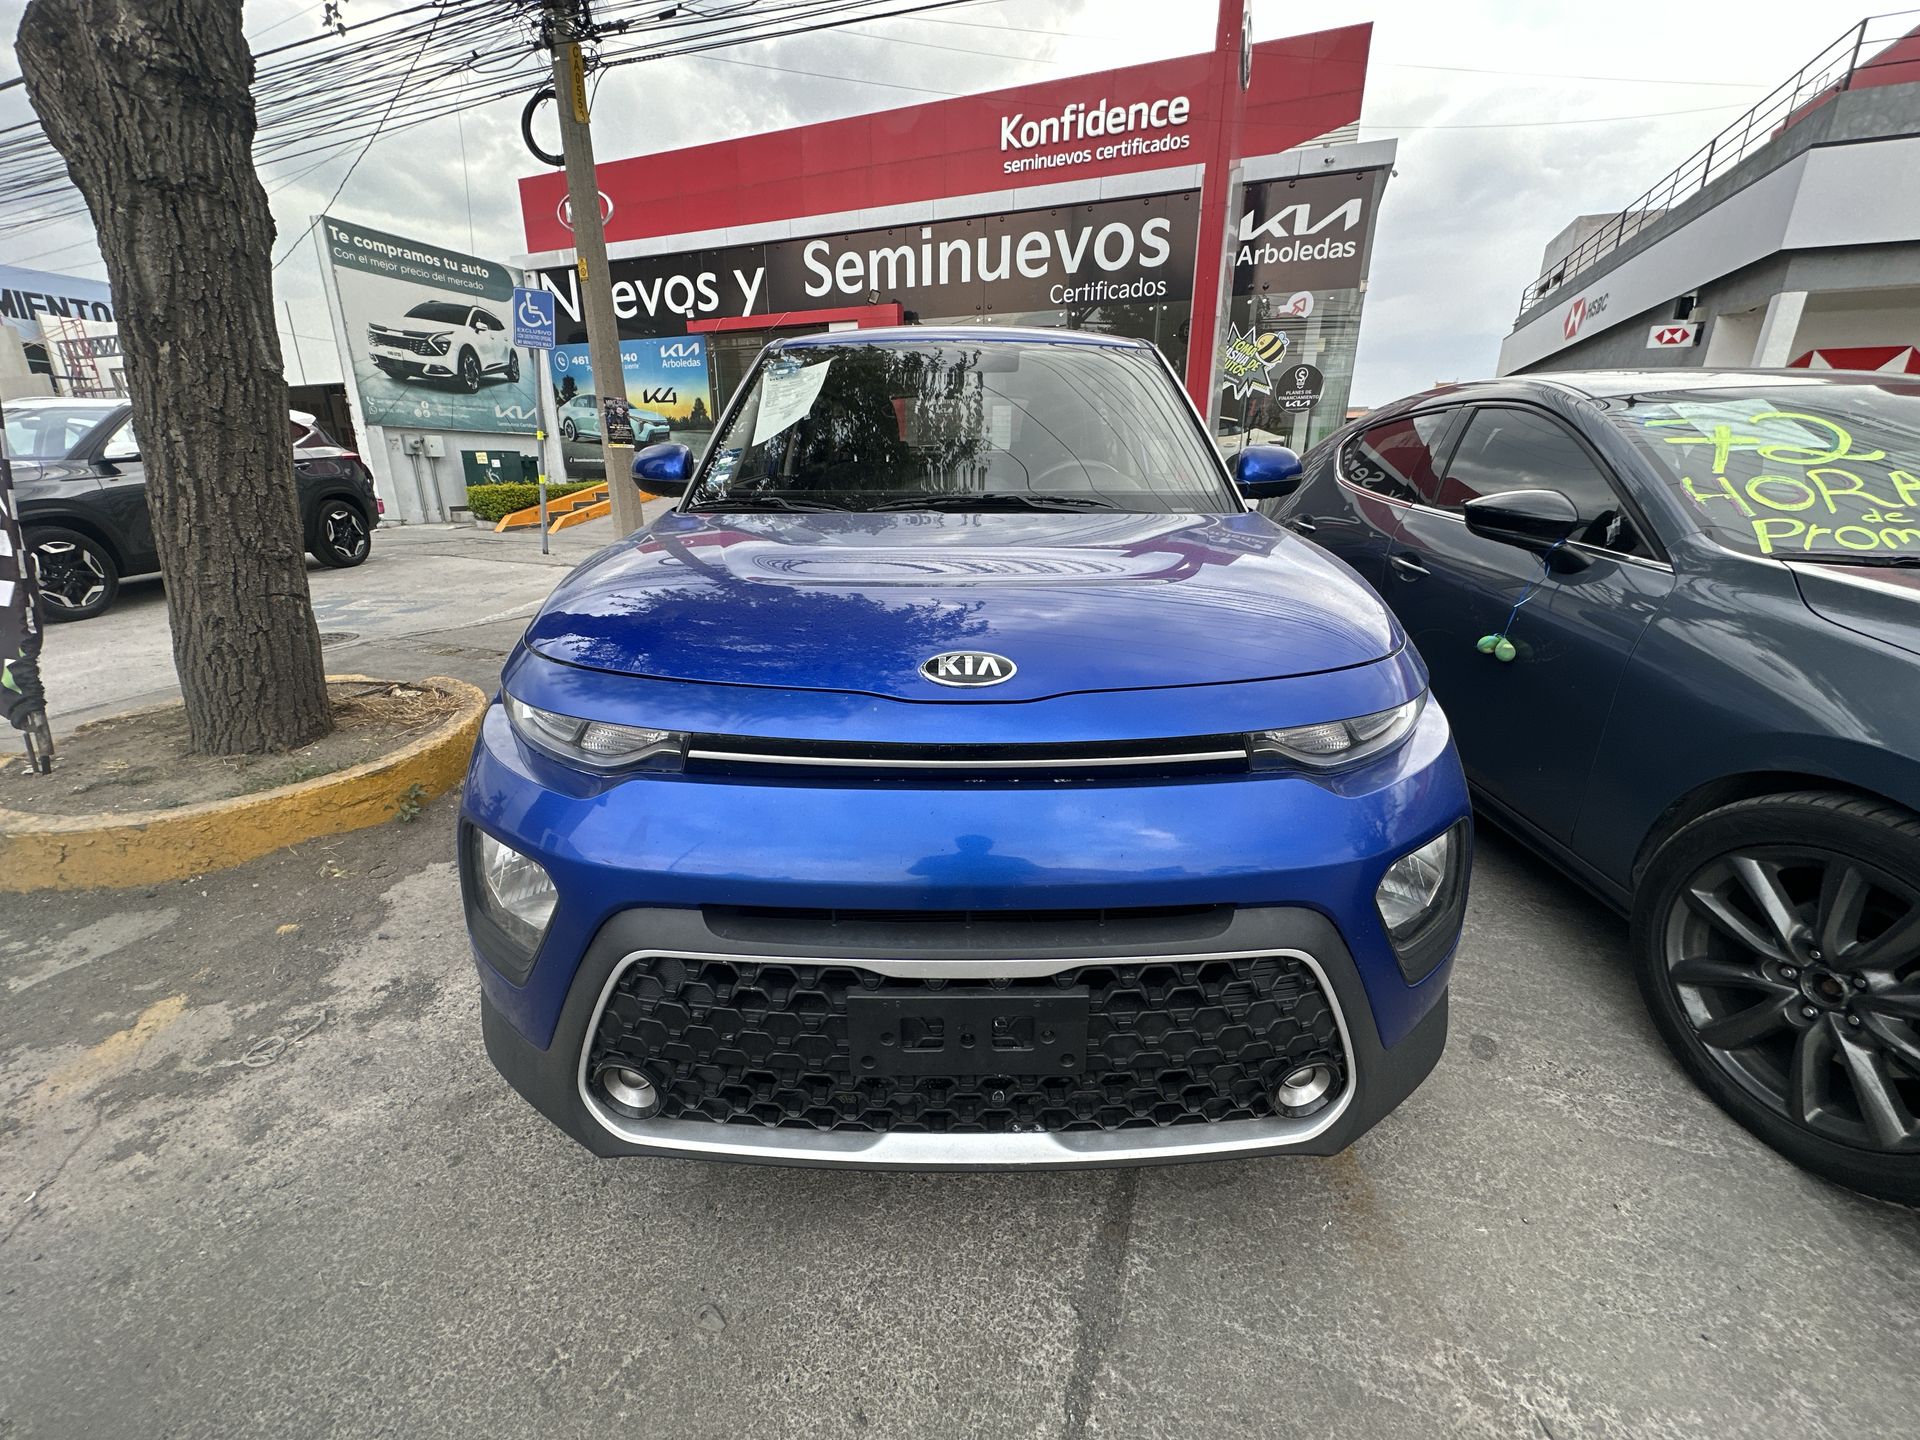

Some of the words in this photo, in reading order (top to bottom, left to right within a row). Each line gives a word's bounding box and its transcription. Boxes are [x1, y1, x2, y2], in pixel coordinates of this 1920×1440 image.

[1000, 95, 1190, 151] Konfidence
[1003, 149, 1092, 174] seminuevos
[1096, 133, 1190, 160] certificados
[1238, 198, 1362, 241] KIA
[328, 224, 350, 244] Te
[353, 236, 441, 267] compramos
[443, 257, 458, 271] tu
[461, 263, 489, 279] auto
[1236, 238, 1356, 266] Arboledas
[333, 247, 356, 261] Con
[358, 254, 368, 264] el
[370, 258, 398, 271] mejor
[400, 265, 430, 279] precio
[431, 272, 446, 283] del
[447, 276, 484, 290] mercado
[541, 270, 719, 323] Nevos
[733, 266, 765, 317] y
[803, 217, 1171, 298] Seminuevos
[1050, 277, 1167, 304] Certificados
[1226, 345, 1250, 366] ASIVA
[1247, 359, 1262, 372] DE
[1232, 338, 1258, 358] TOMA
[662, 358, 701, 368] Arboledas
[1861, 507, 1915, 523] de
[937, 655, 1002, 677] KIA
